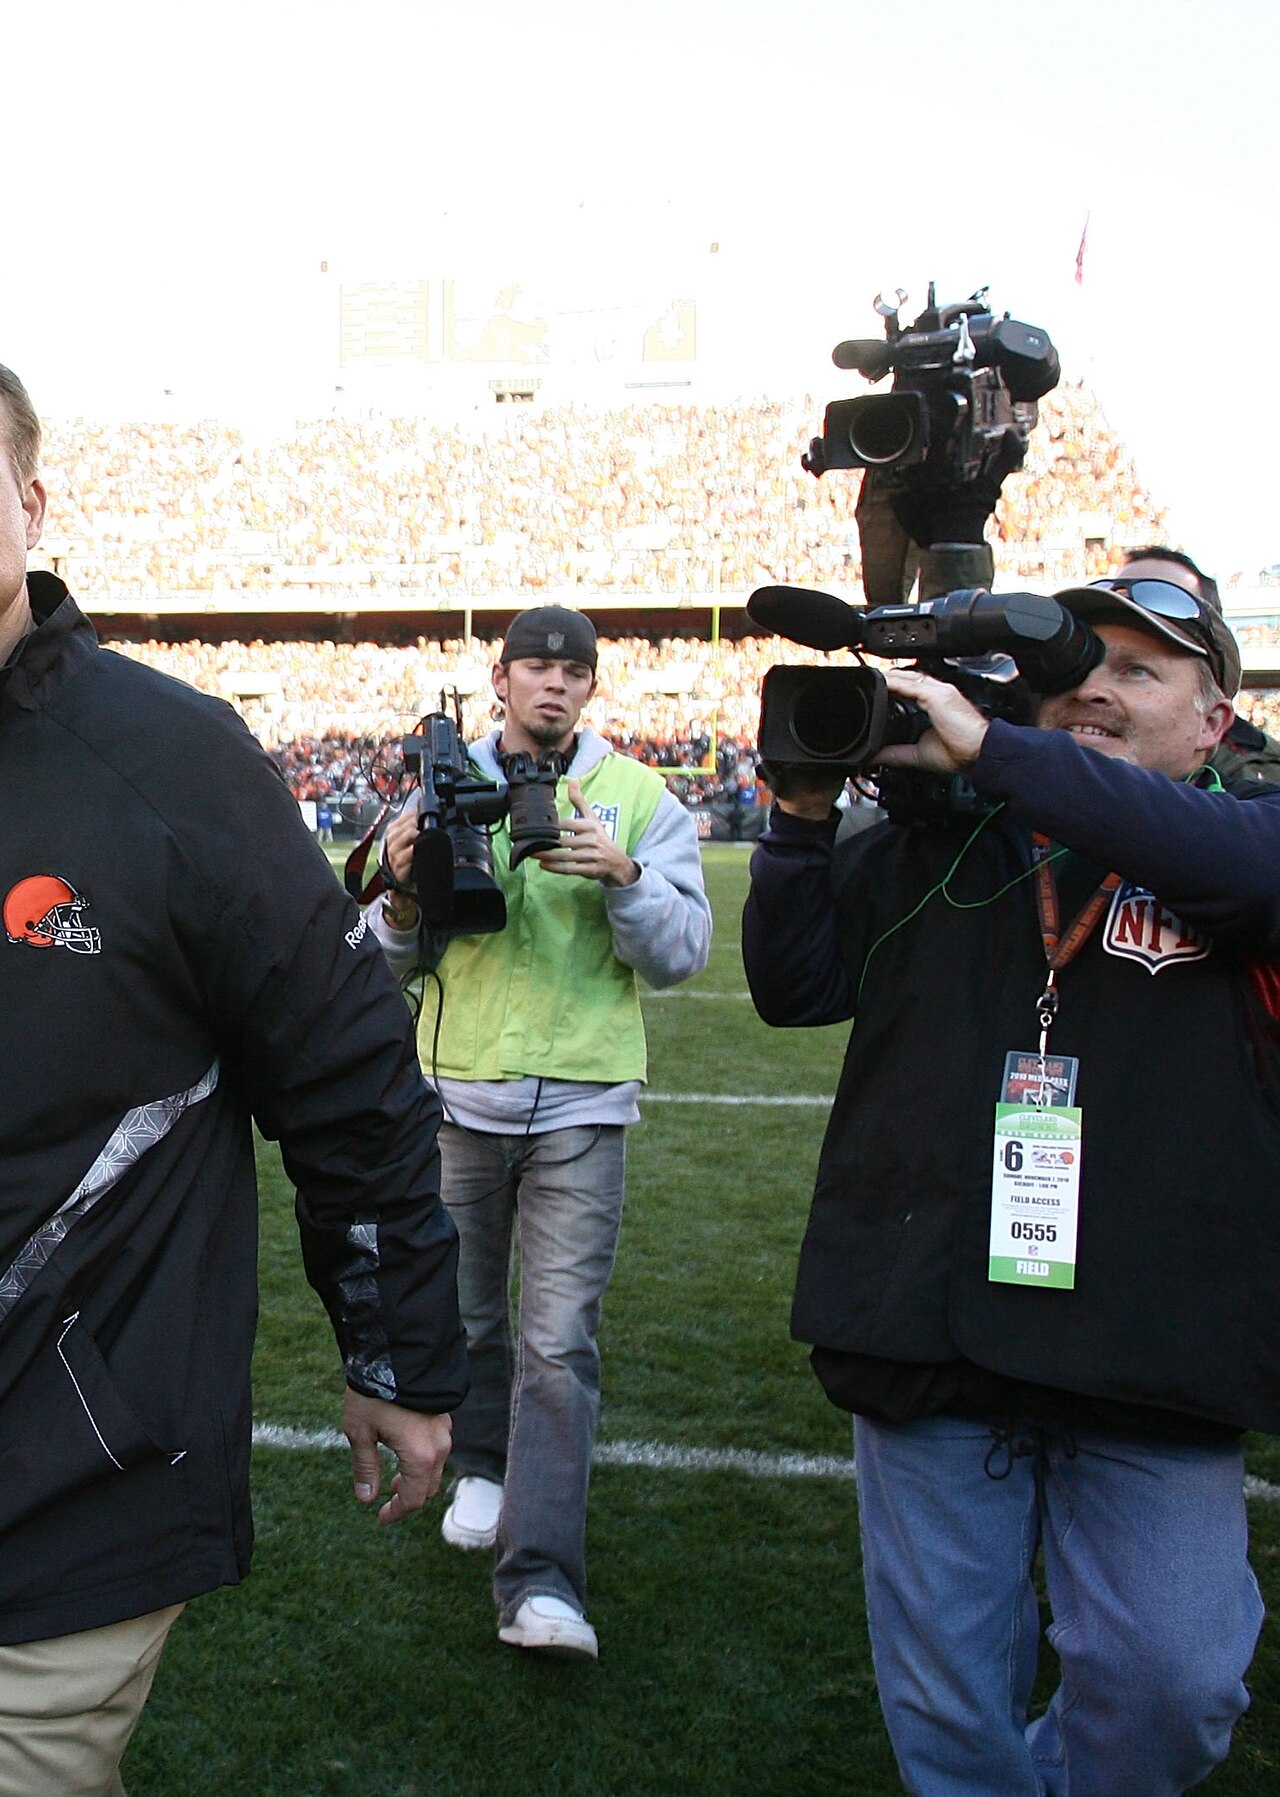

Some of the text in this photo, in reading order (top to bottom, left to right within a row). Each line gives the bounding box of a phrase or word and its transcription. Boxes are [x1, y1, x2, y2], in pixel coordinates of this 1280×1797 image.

[1005, 1140, 1024, 1172] 6
[1031, 1197, 1061, 1206] ACCESS
[1010, 1221, 1057, 1242] 0555
[1016, 1260, 1050, 1277] FIELD
